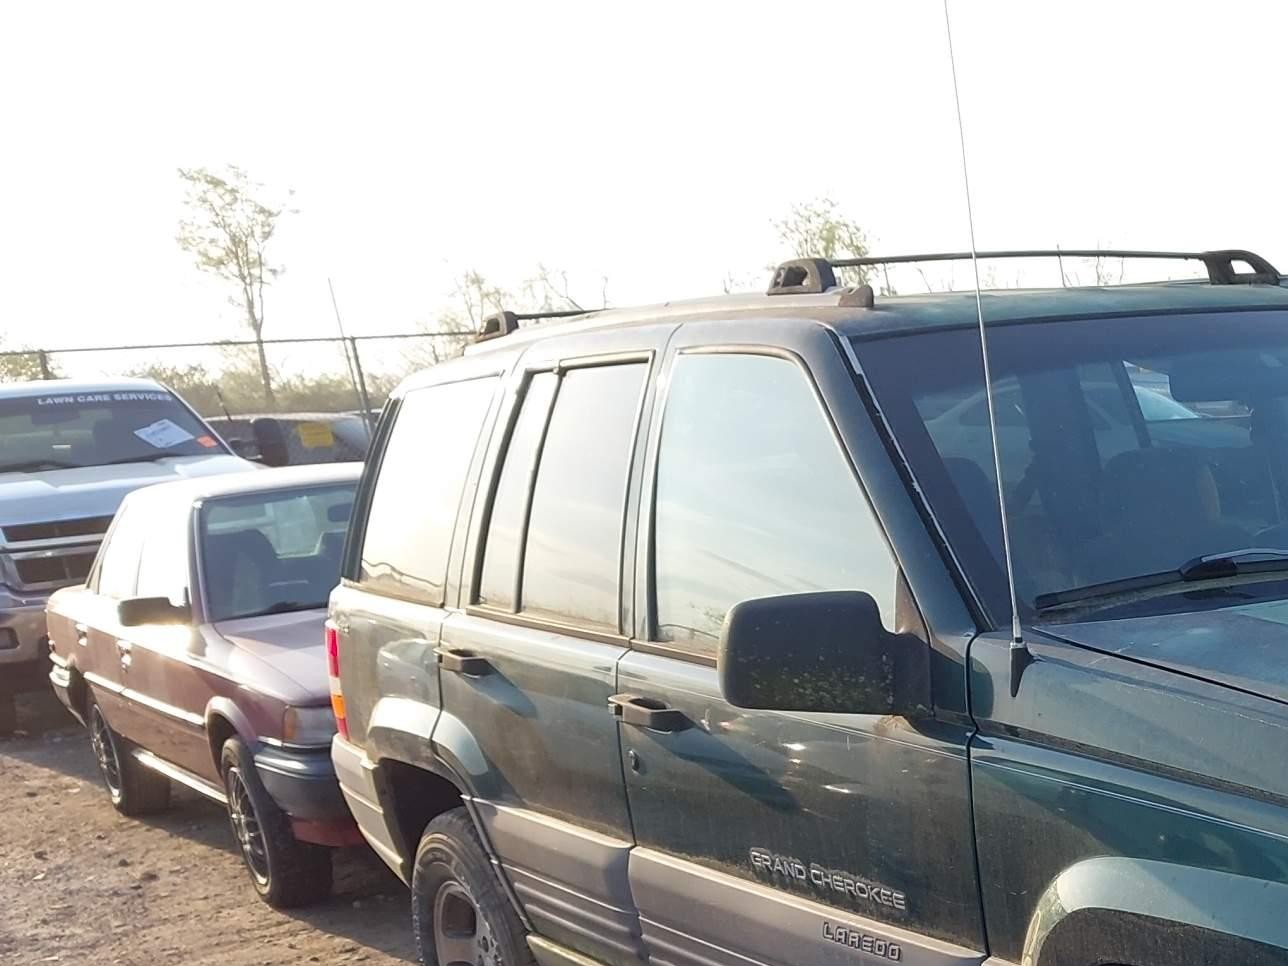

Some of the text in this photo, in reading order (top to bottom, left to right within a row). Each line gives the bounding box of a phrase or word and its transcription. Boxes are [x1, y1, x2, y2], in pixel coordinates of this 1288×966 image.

[37, 392, 173, 405] LAWN CARE SERVICES
[751, 851, 906, 910] GRAND CHEROKEE
[823, 921, 902, 961] LAREDO
